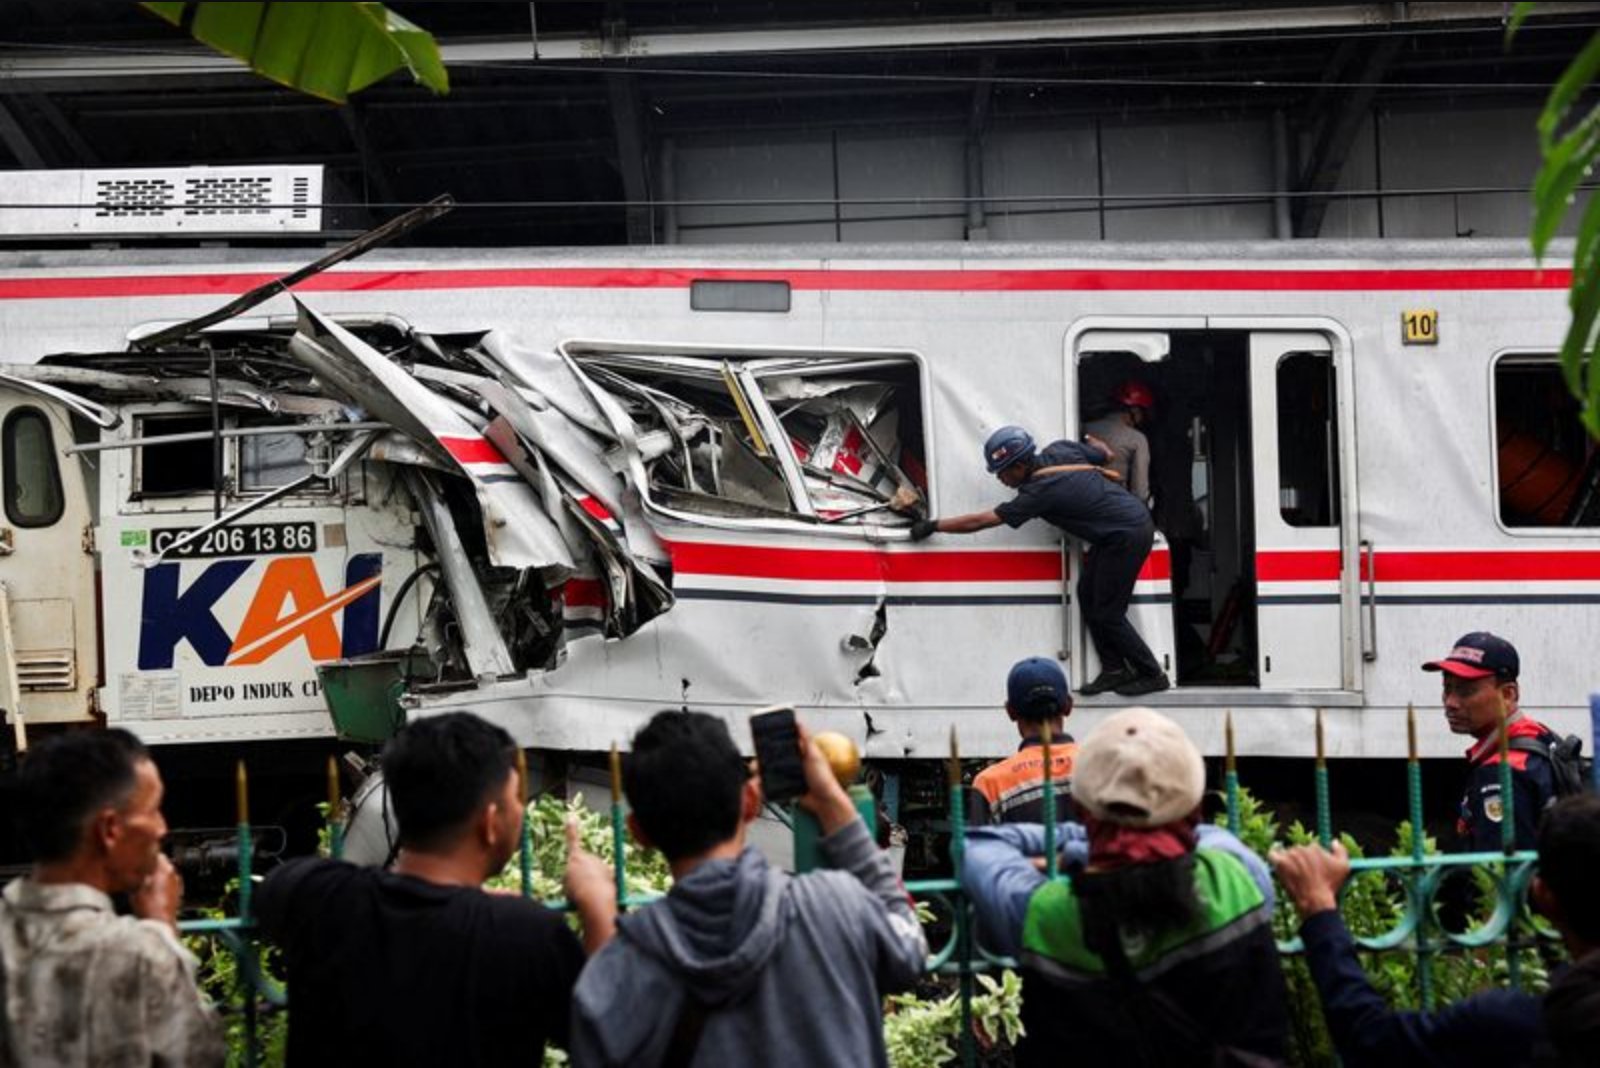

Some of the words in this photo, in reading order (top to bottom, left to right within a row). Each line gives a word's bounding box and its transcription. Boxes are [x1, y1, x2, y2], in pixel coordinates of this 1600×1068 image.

[1409, 314, 1431, 336] 10
[200, 528, 245, 553] 206
[250, 526, 276, 550] 13
[283, 525, 311, 549] 86
[138, 553, 383, 670] KAI
[190, 684, 235, 702] DEPO
[243, 681, 294, 700] INDUK
